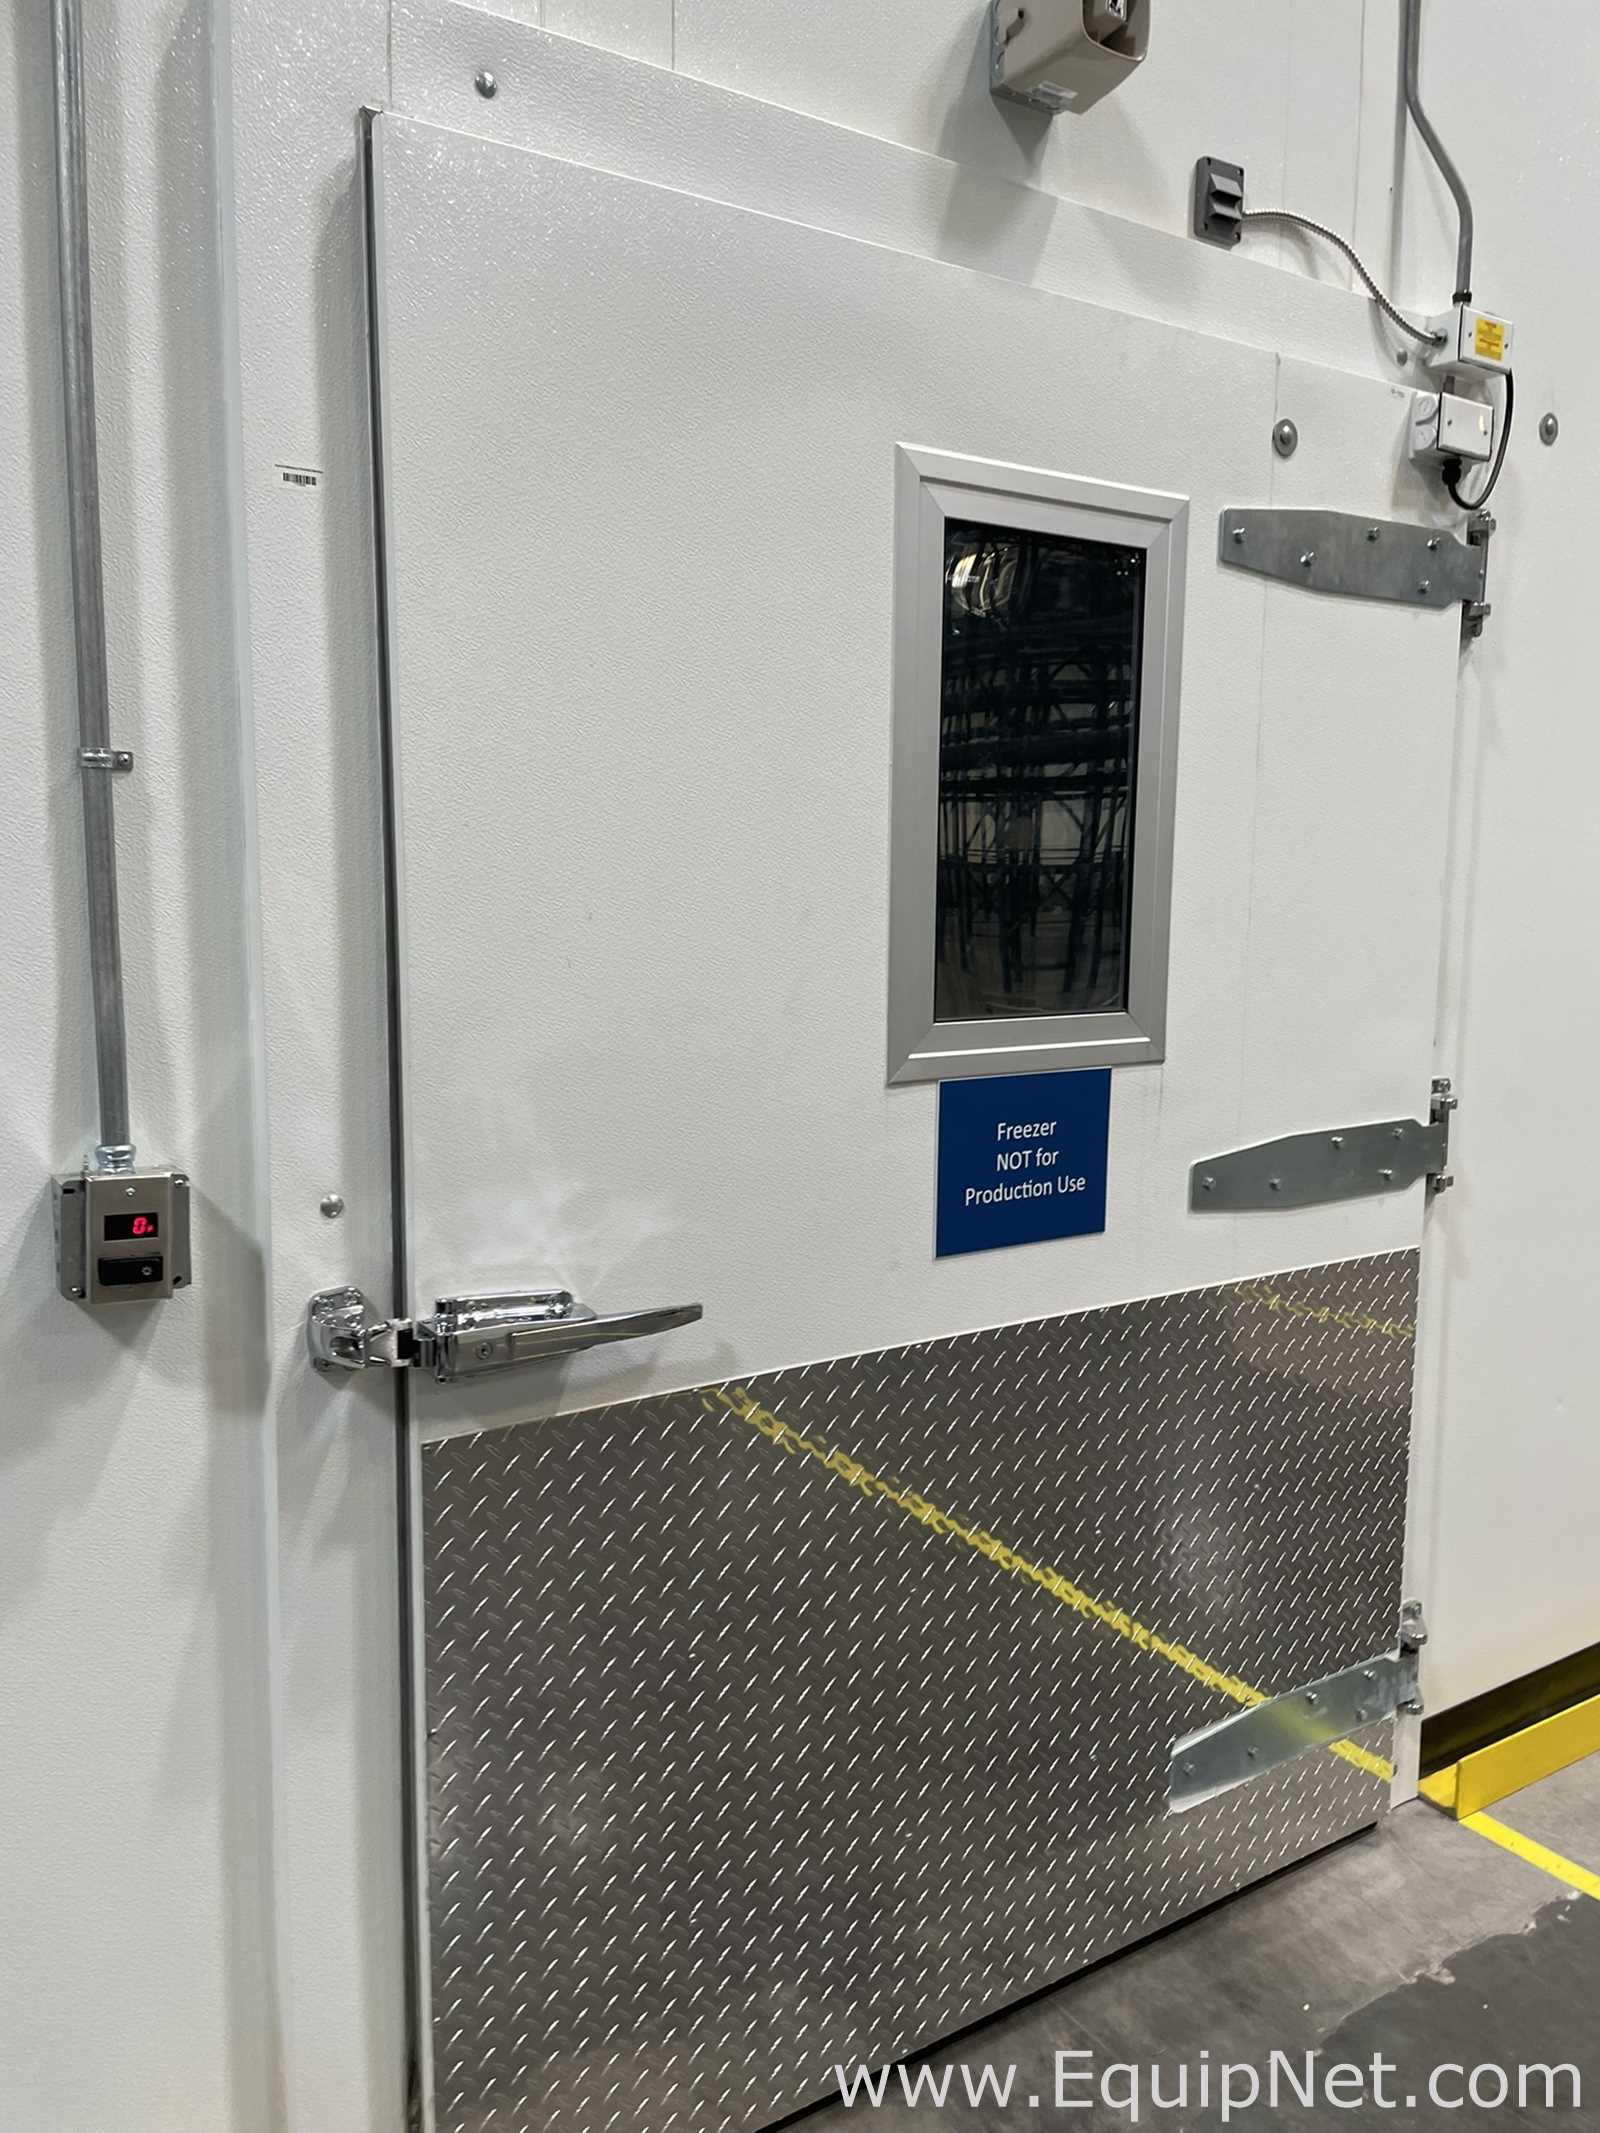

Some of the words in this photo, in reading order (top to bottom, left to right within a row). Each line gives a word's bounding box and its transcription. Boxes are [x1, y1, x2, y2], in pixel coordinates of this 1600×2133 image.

[997, 1121, 1057, 1141] Freezer
[996, 1150, 1032, 1172] NOT
[1035, 1147, 1059, 1167] for
[965, 1179, 1053, 1206] Production
[1057, 1175, 1086, 1194] Use
